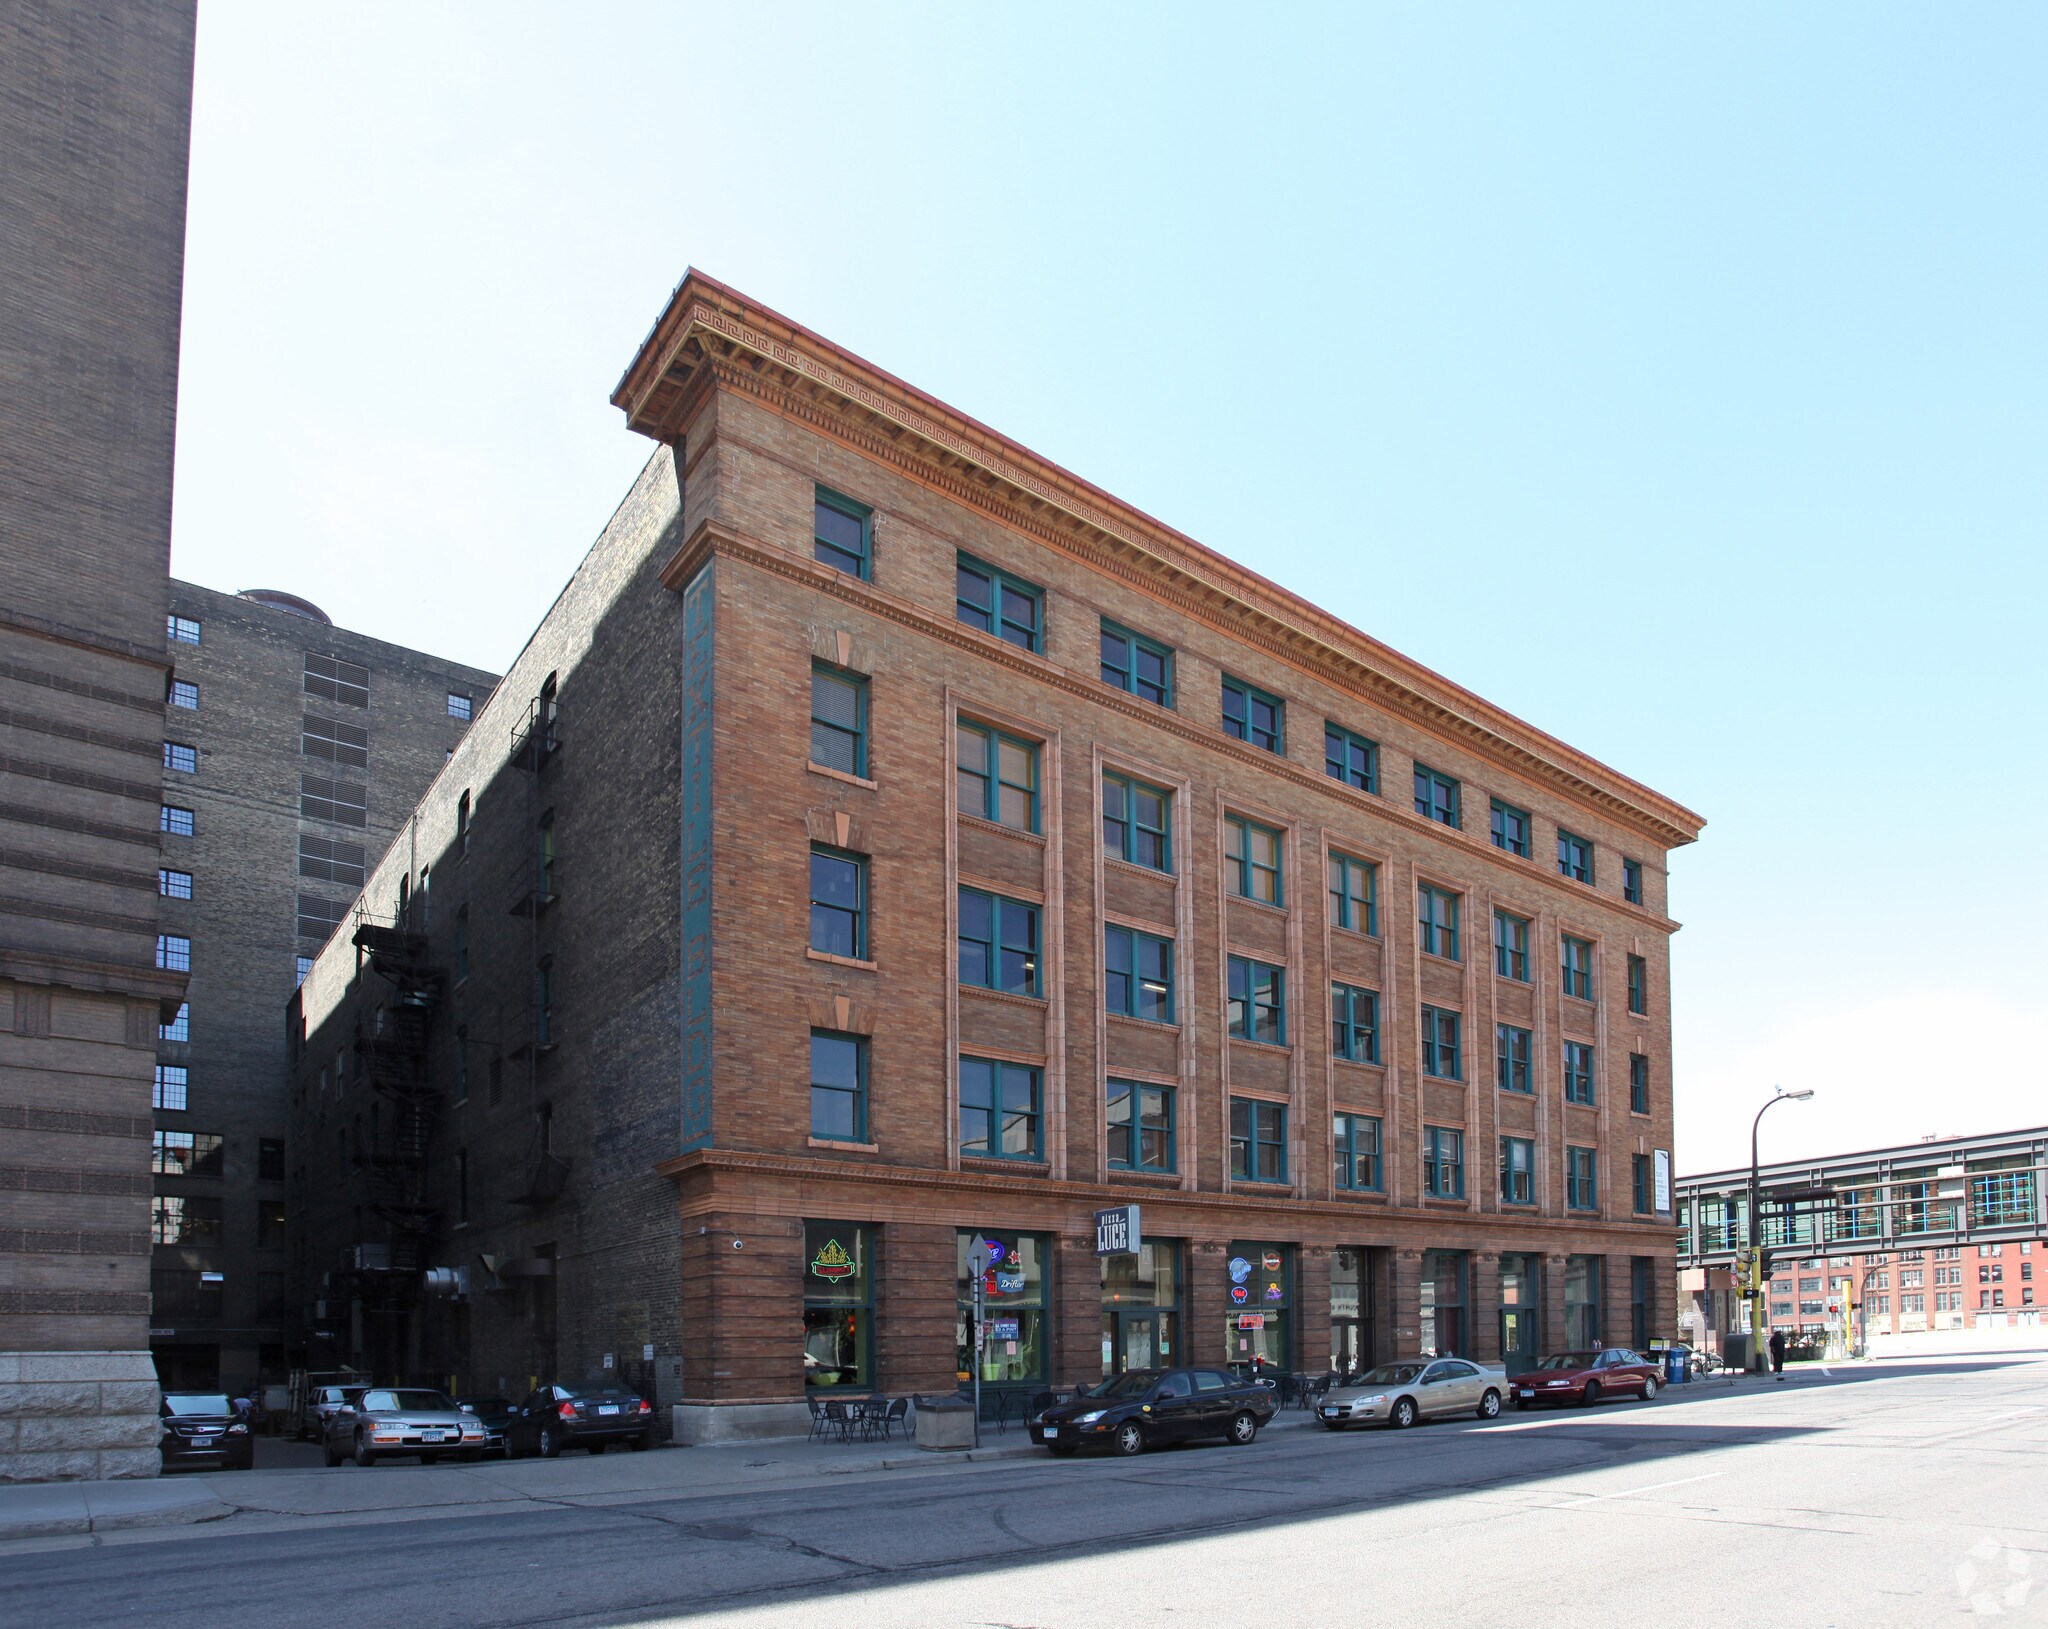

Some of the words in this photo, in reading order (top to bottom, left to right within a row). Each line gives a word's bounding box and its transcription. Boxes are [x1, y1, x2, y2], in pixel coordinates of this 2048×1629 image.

[687, 577, 709, 911] TEXTILE
[1101, 1213, 1120, 1227] pizza
[1097, 1217, 1127, 1251] LUCÉ
[1240, 1315, 1263, 1328] OPEN
